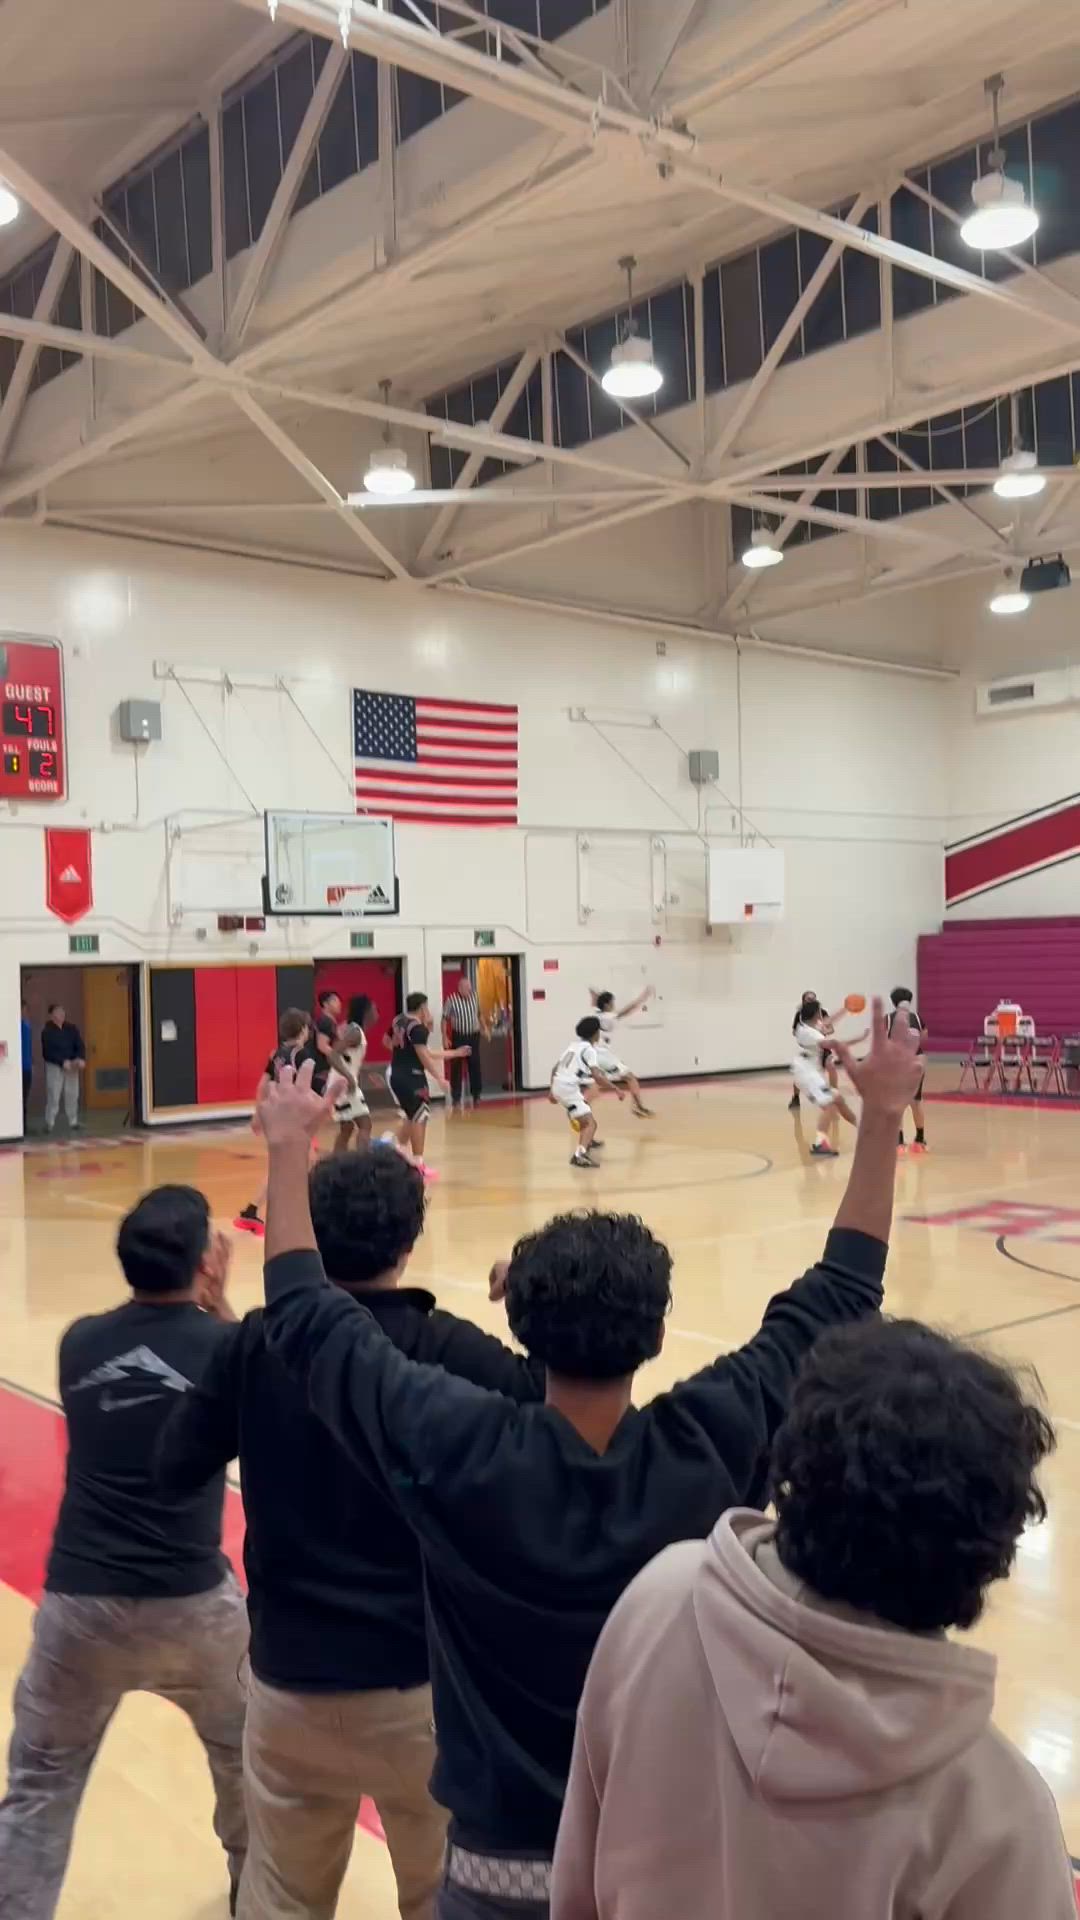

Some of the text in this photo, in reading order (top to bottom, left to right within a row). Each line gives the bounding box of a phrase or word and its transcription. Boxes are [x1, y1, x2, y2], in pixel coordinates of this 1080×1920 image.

[5, 683, 51, 702] GUEST
[15, 706, 53, 735] 47
[27, 737, 58, 752] FOULS
[39, 752, 53, 777] 2
[28, 779, 58, 793] SCORE
